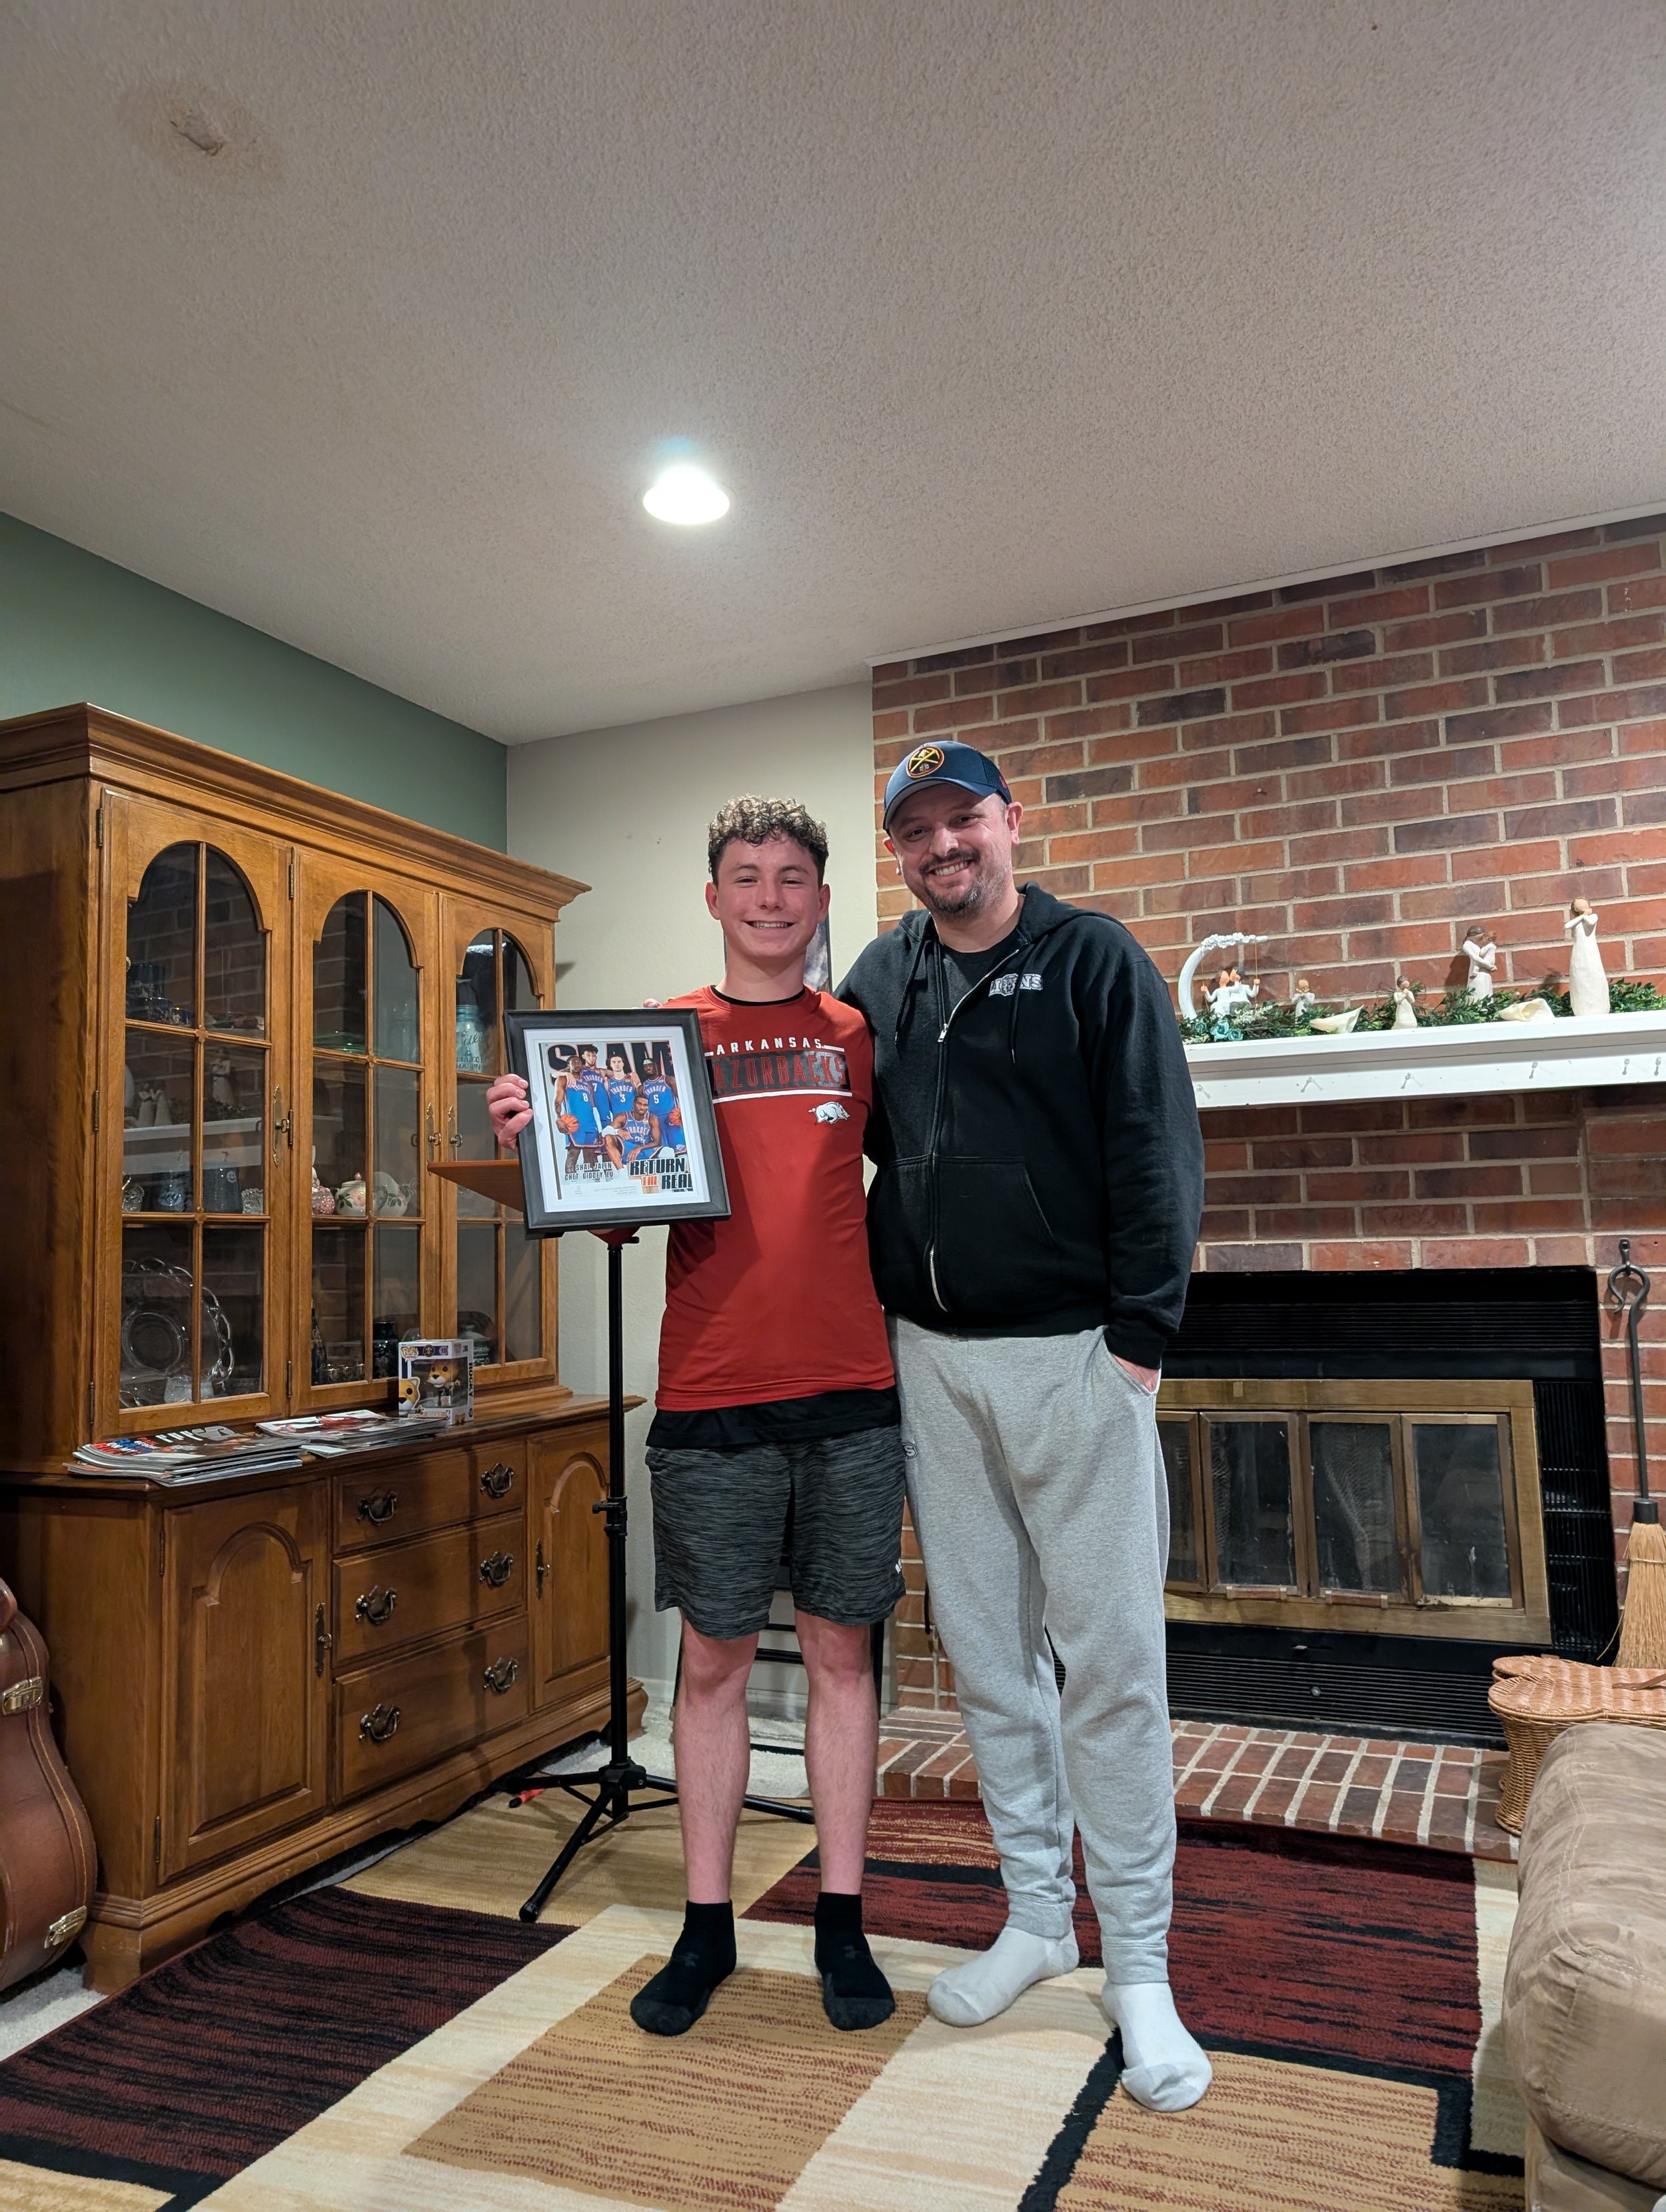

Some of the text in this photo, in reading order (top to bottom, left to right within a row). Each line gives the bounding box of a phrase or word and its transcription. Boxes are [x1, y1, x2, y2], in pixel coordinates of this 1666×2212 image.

[716, 1036, 822, 1055] ARKANSAS
[582, 1093, 588, 1102] 8
[619, 1093, 626, 1103] 3
[653, 1094, 659, 1104] 5
[630, 1158, 686, 1176] RETURN
[641, 1176, 659, 1187] THE
